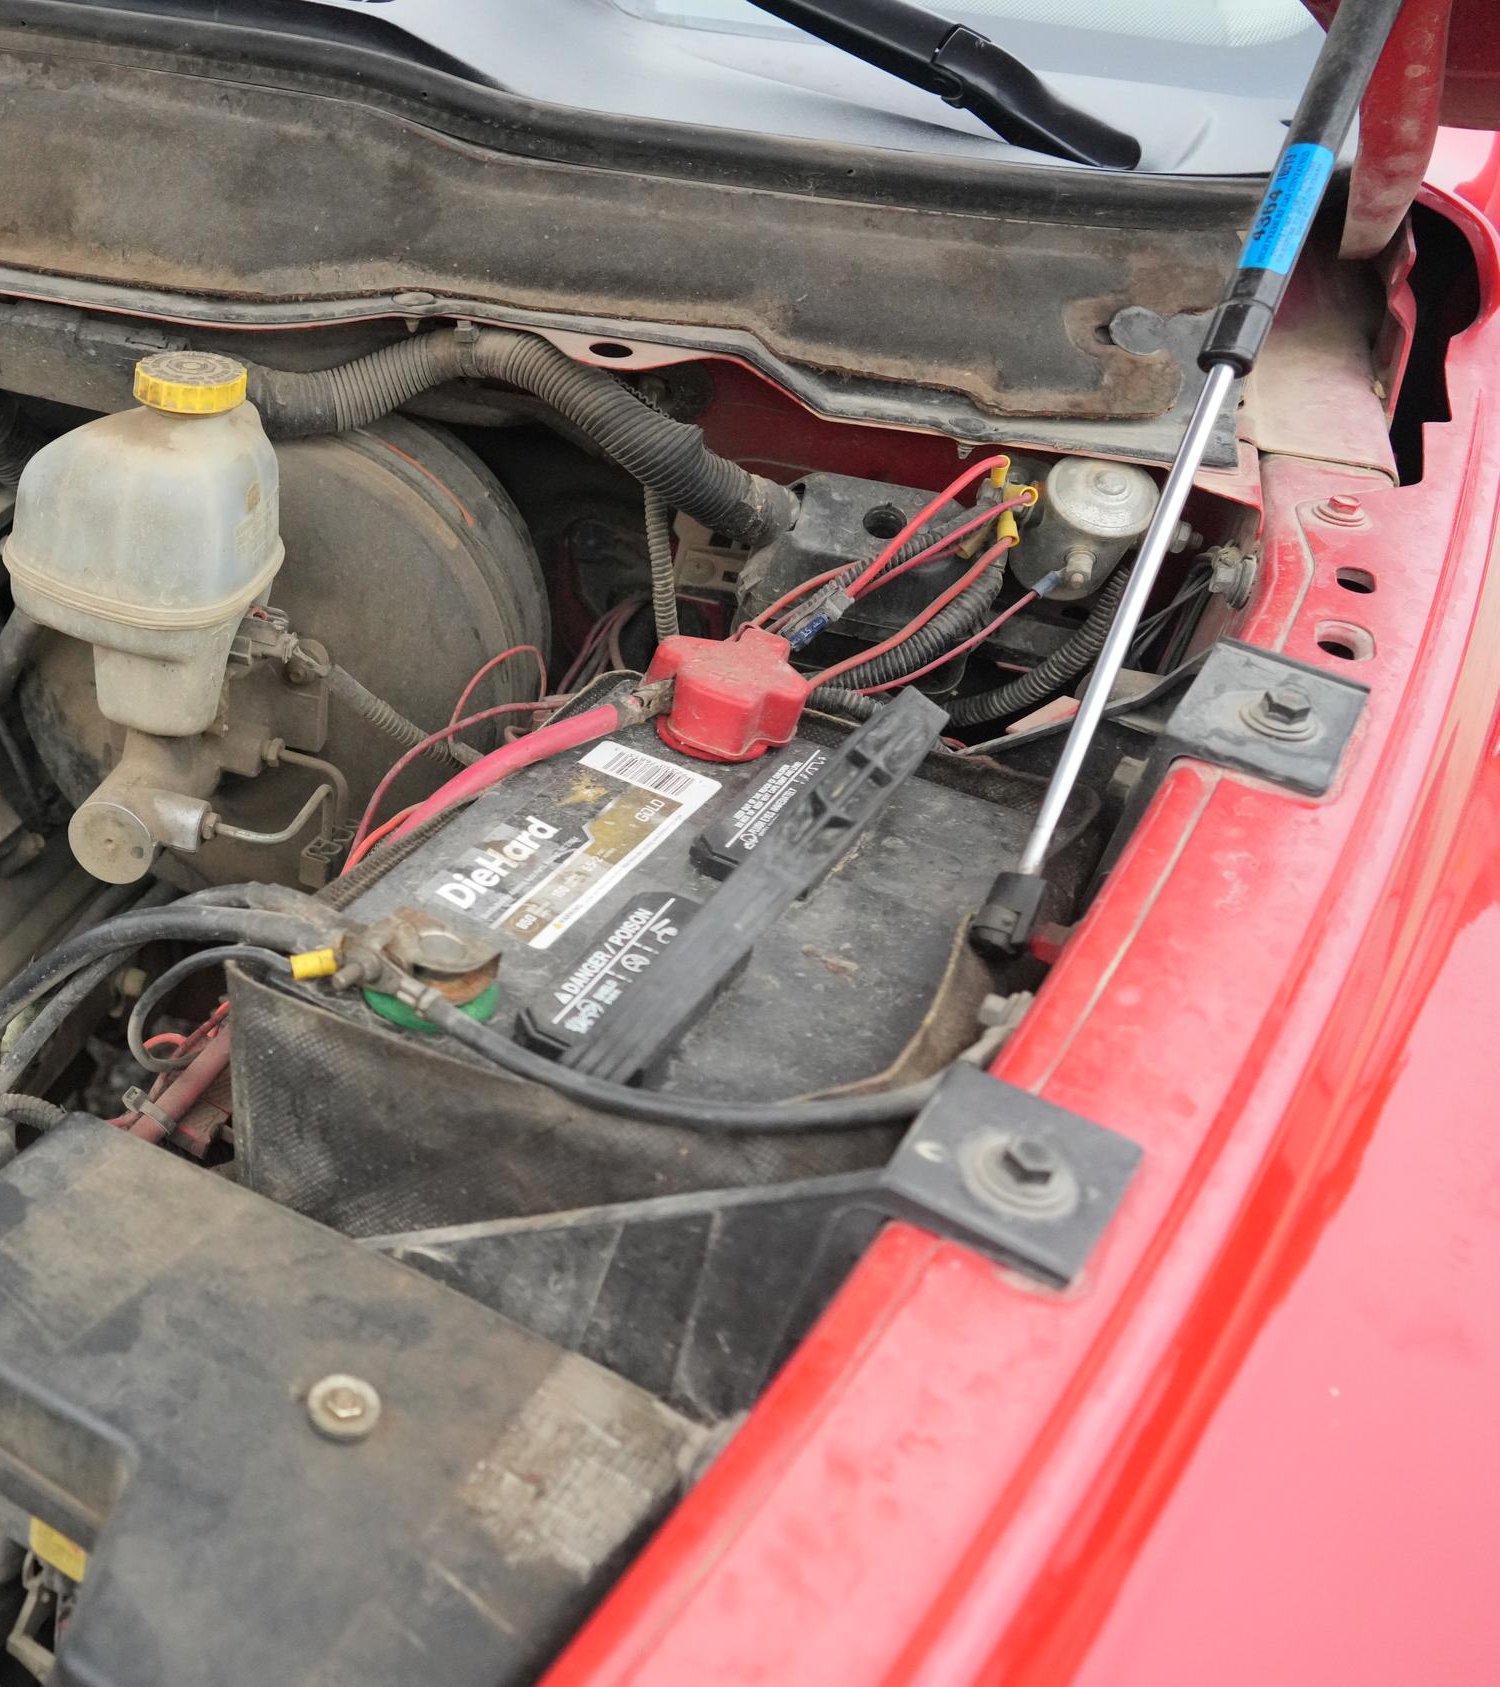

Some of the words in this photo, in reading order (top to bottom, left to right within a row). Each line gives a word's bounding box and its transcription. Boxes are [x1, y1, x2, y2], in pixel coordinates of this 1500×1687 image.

[635, 799, 665, 822] GOLD
[437, 818, 558, 909] DieHard
[563, 952, 612, 995] DANGER
[611, 908, 653, 946] POISON
